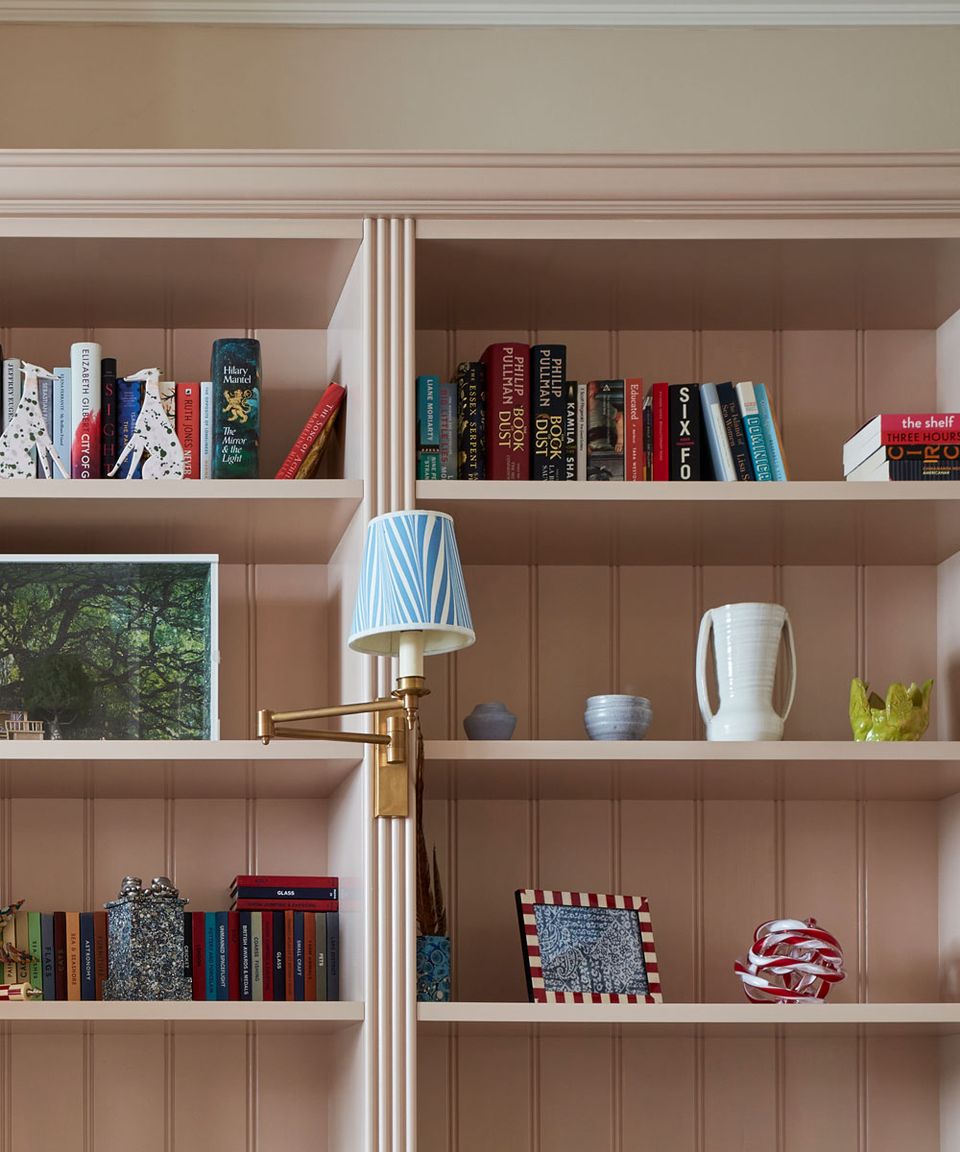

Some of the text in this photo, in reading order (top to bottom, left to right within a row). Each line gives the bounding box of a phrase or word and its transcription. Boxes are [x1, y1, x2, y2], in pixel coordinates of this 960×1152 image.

[223, 365, 248, 376] Hilary
[223, 375, 251, 384] Mantel
[503, 347, 513, 405] PULLMAN
[514, 356, 524, 396] PHILIP
[539, 350, 550, 407] PULLMAN
[551, 358, 562, 397] PHILIP
[82, 349, 90, 432] ELIZABETH GILBERT
[630, 384, 639, 420] Educated
[183, 399, 192, 448] RUTH JONES
[299, 404, 334, 454] THE SONG OF
[512, 407, 524, 452] BOOK
[679, 386, 690, 436] SIX
[902, 415, 955, 428] the shelf
[81, 433, 90, 453] CITY
[222, 436, 247, 445] Mirror
[223, 426, 237, 436] The
[498, 411, 511, 449] DUST
[535, 419, 548, 457] DUST
[549, 416, 562, 460] BOOK
[567, 402, 575, 480] KAMILA SHA
[724, 419, 735, 447] Women
[887, 432, 960, 442] THREE HOURS
[81, 455, 90, 469] OF
[222, 445, 242, 453] & the
[222, 453, 242, 464] Light
[736, 453, 746, 473] Lisa
